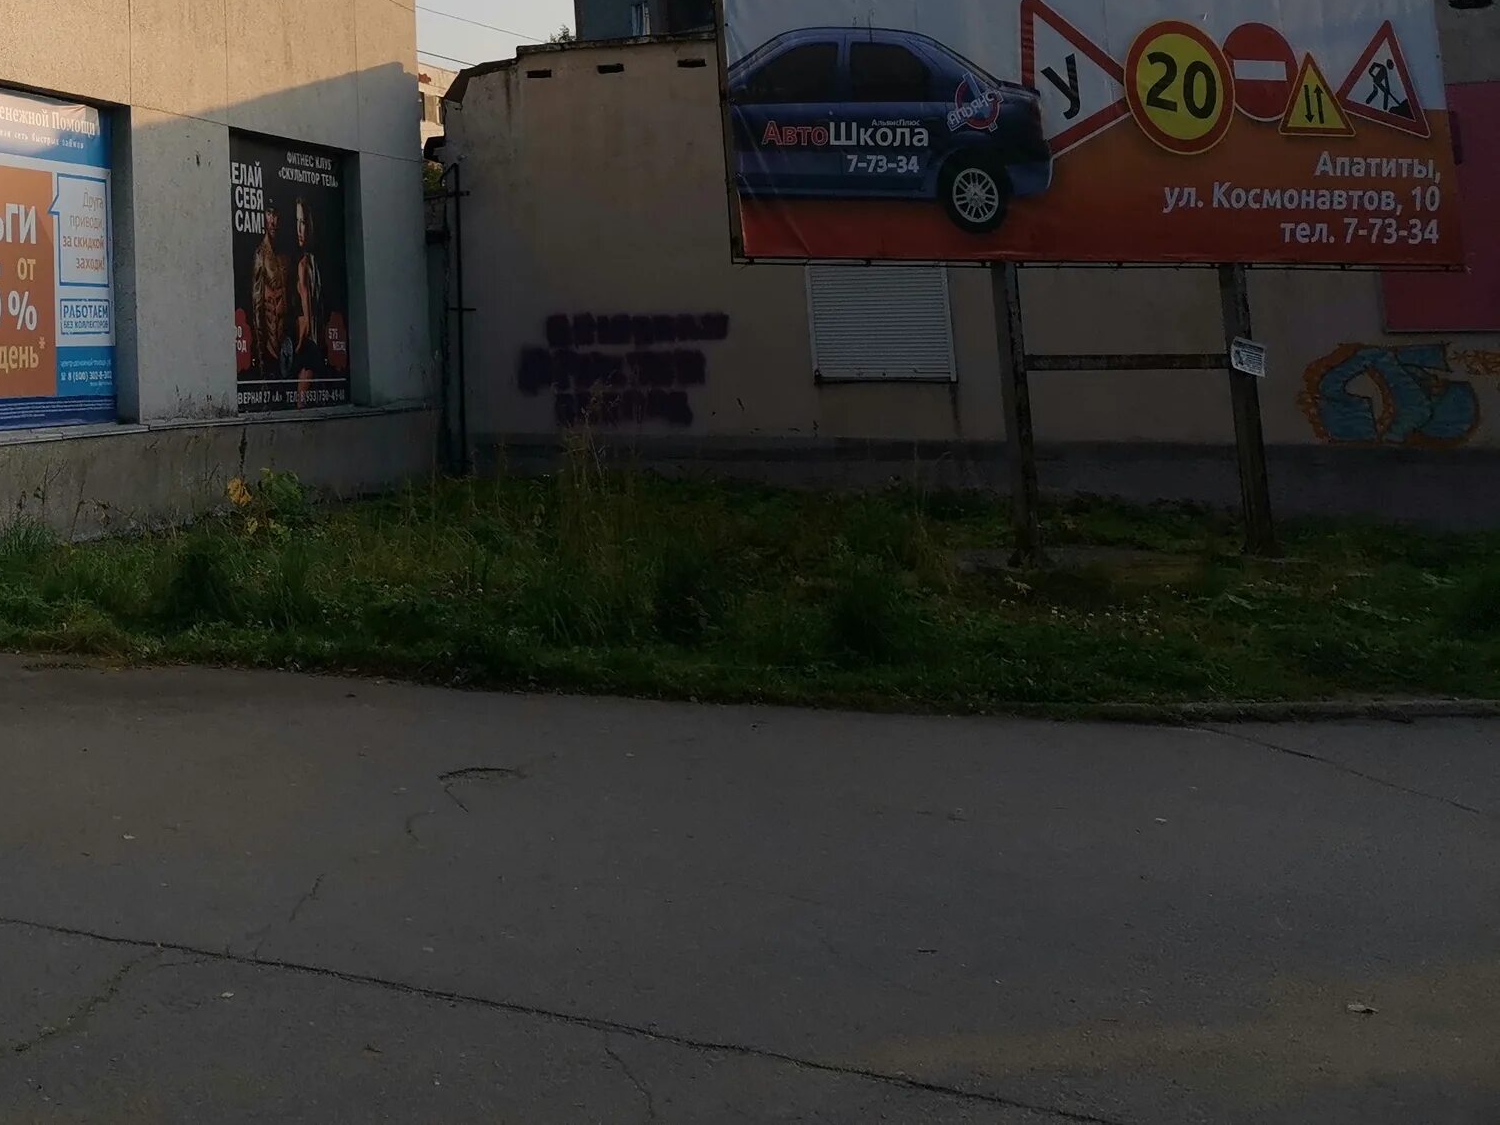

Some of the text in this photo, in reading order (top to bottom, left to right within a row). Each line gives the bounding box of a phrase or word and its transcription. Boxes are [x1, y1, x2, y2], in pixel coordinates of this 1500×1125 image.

[1145, 51, 1218, 120] 20
[52, 111, 96, 137] Помощи
[762, 120, 930, 148] АвтоШкола
[847, 155, 920, 173] 7-73-34
[1314, 151, 1441, 184] Апатиты,
[235, 185, 264, 211] СЕБЯ
[1162, 181, 1441, 217] ул. Космонавтов, 10
[235, 209, 266, 234] САМ!
[1281, 217, 1440, 245] тел. 7-73-34
[62, 236, 73, 248] за
[17, 257, 36, 282] от
[63, 304, 108, 319] РАБОТАЕМ
